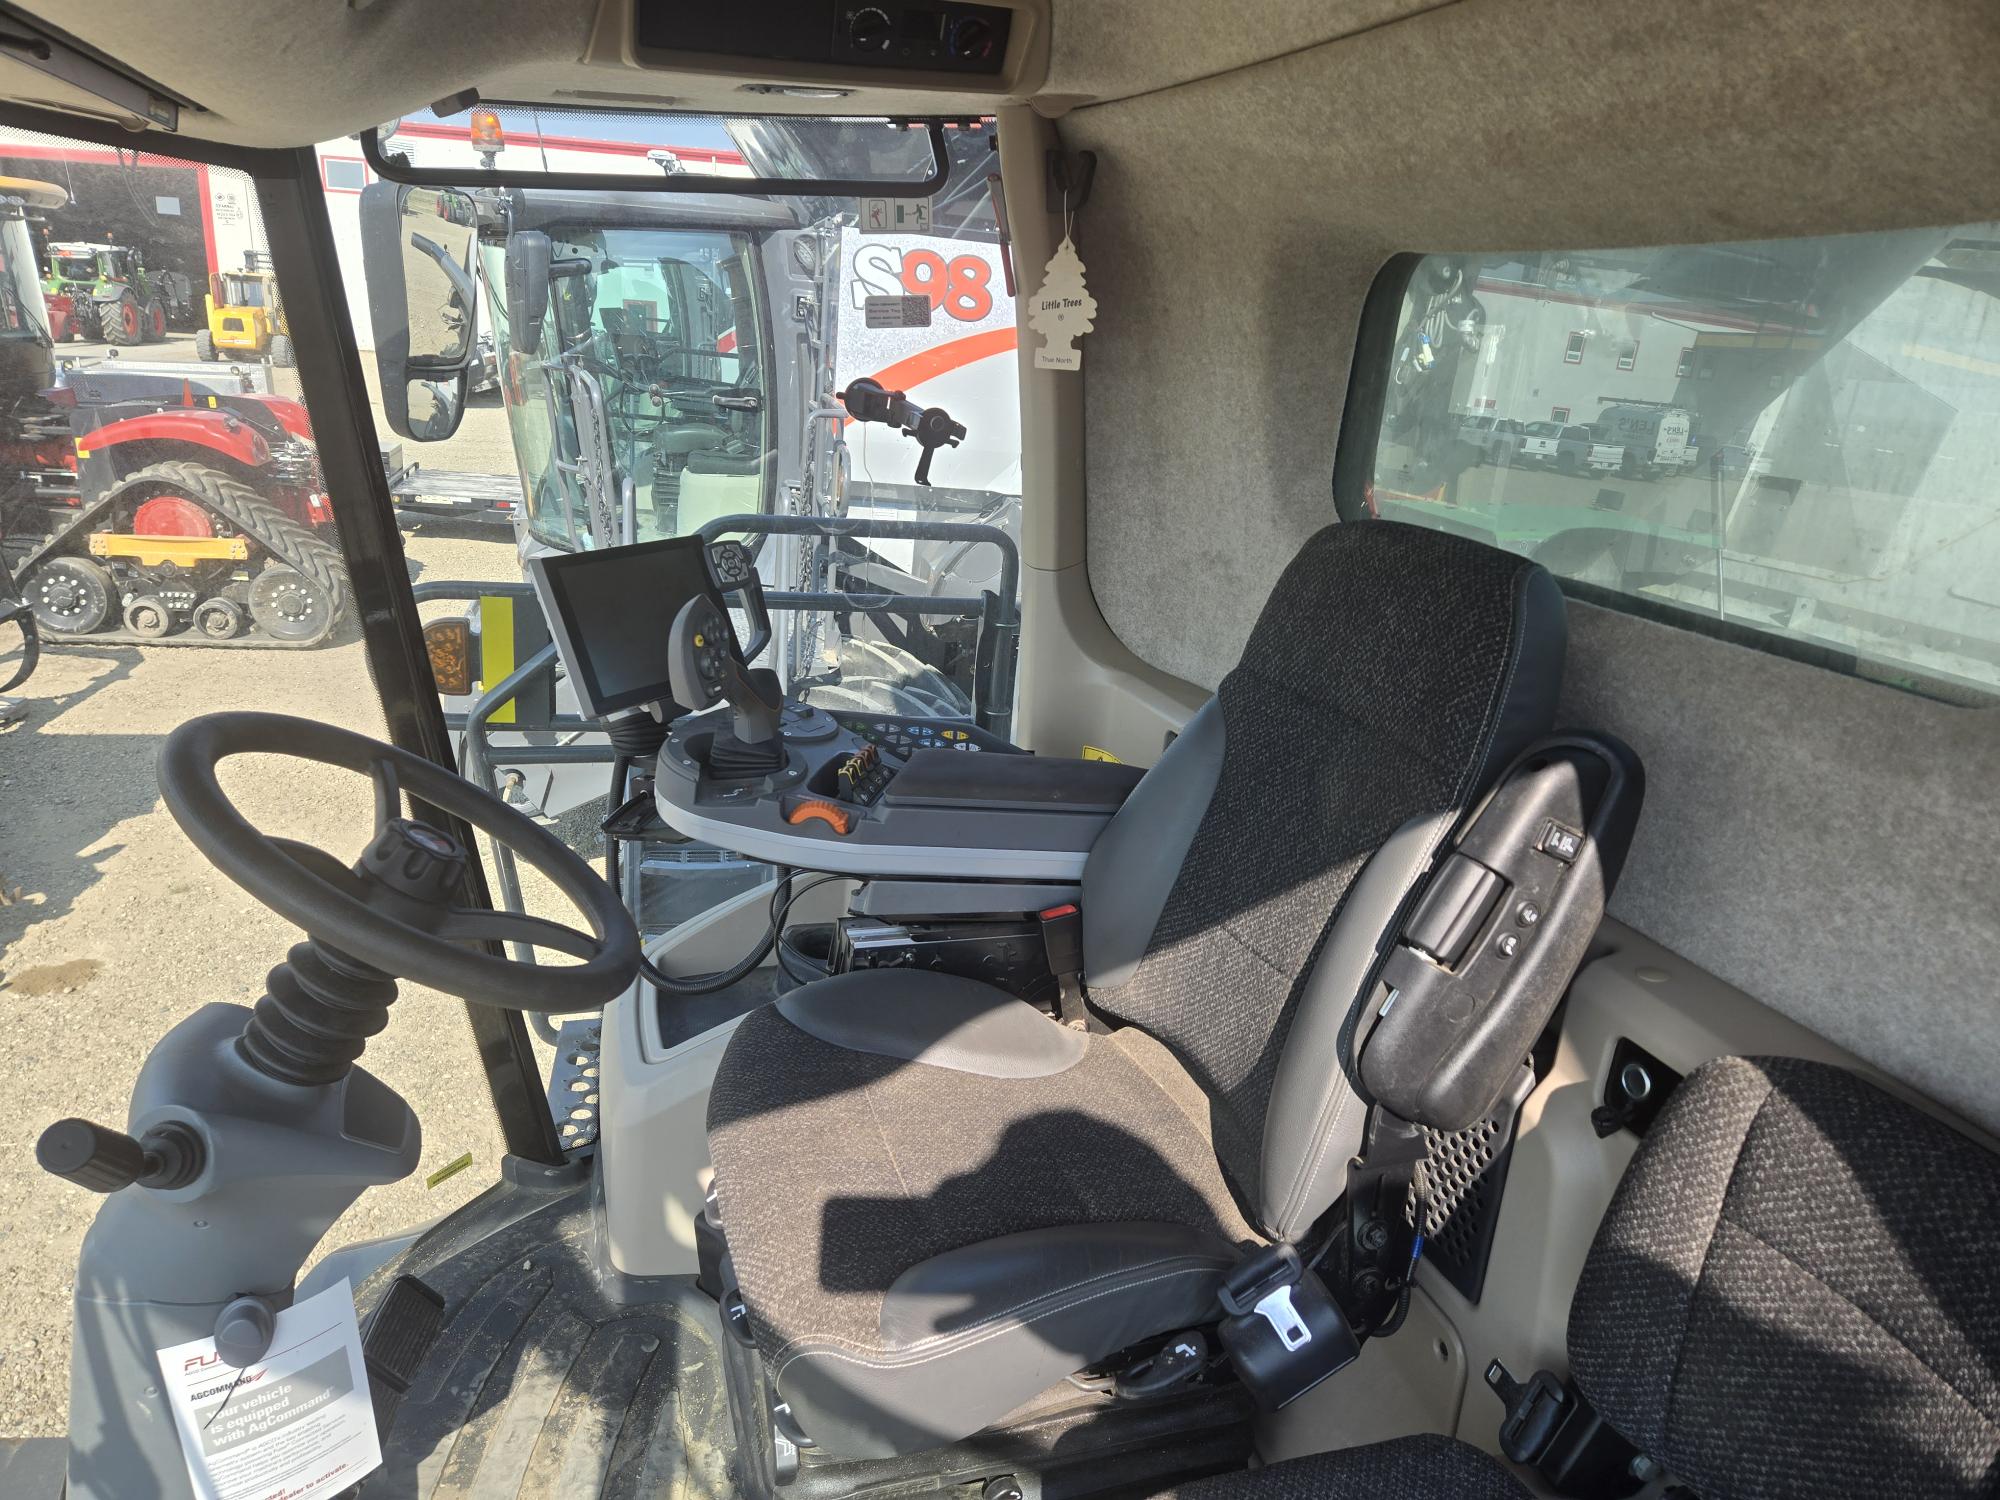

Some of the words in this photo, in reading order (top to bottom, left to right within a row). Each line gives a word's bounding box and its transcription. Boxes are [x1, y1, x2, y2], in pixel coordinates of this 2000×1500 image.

[850, 243, 993, 322] S98
[1041, 299, 1060, 311] Little
[1062, 297, 1082, 308] Trees
[1042, 355, 1055, 363] True
[185, 1352, 222, 1371] FU
[190, 1375, 252, 1401] AGCOMMAND
[206, 1404, 240, 1420] Your
[241, 1384, 293, 1410] vehicle
[210, 1422, 225, 1435] is
[226, 1397, 290, 1429] equipped
[212, 1428, 246, 1447] with
[305, 1481, 315, 1489] to
[315, 1463, 349, 1484] activate.
